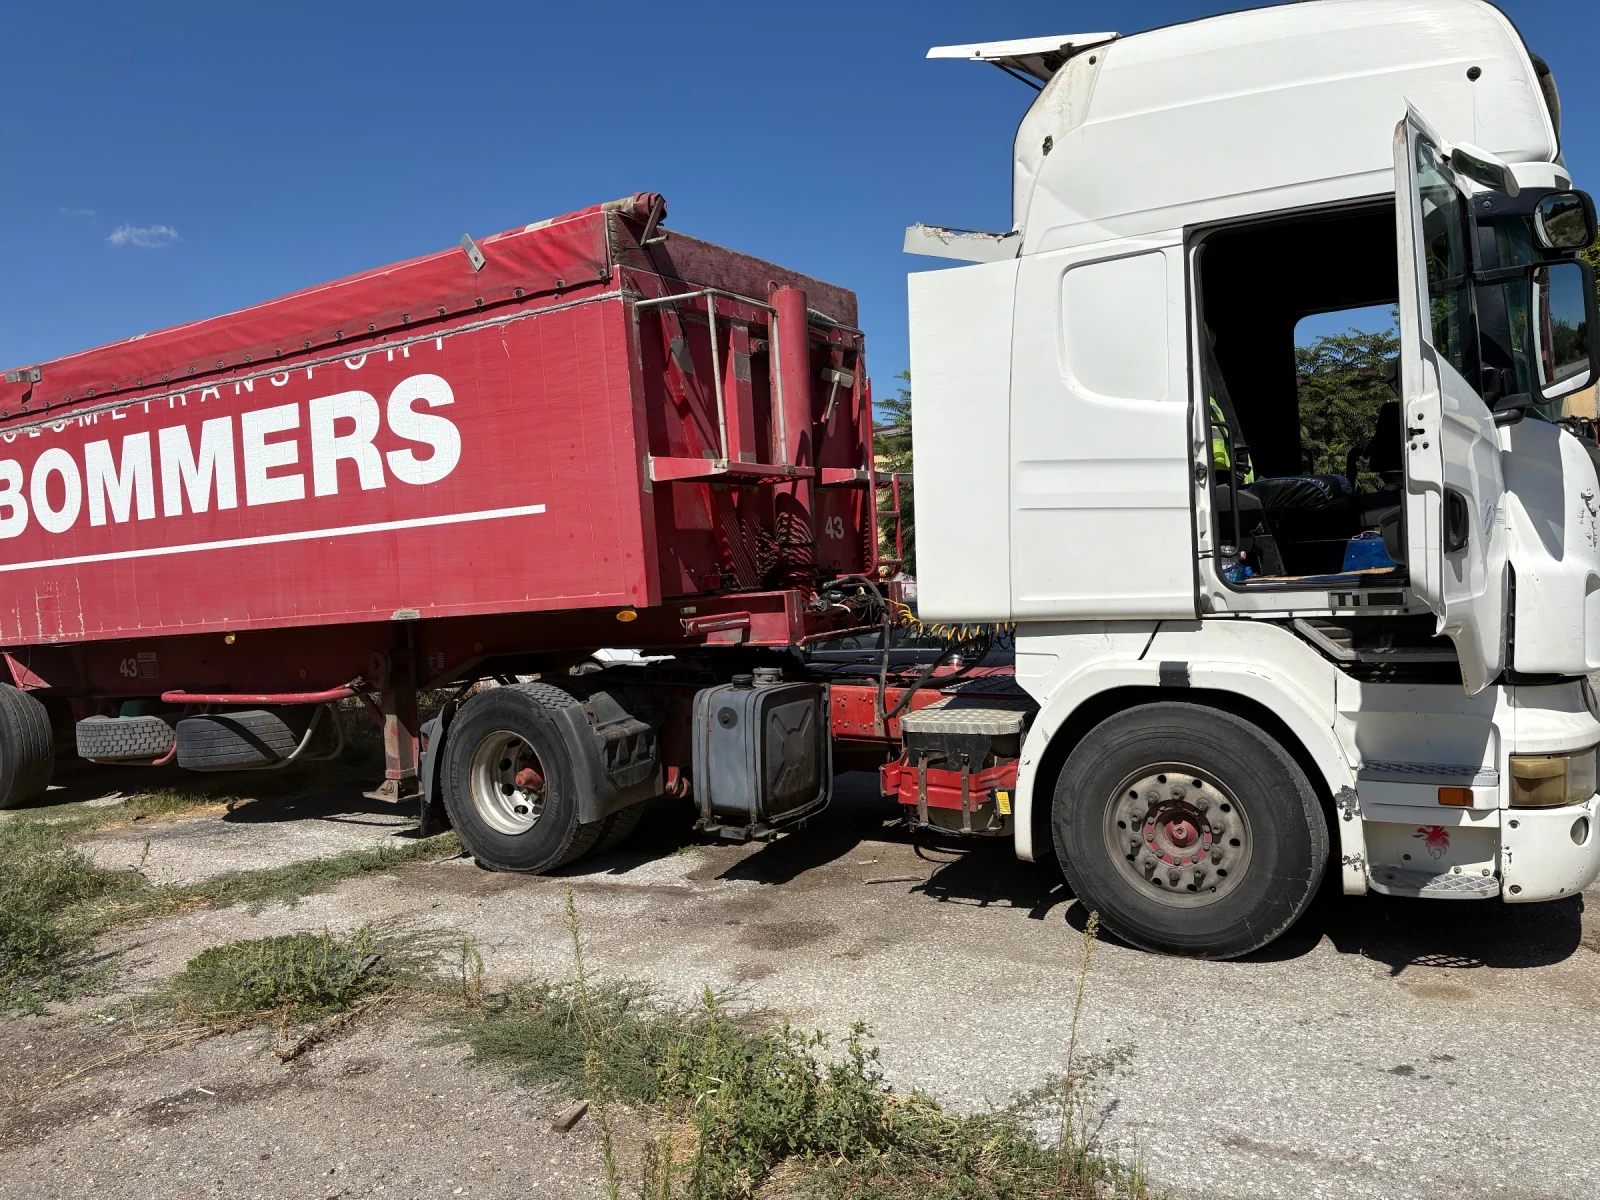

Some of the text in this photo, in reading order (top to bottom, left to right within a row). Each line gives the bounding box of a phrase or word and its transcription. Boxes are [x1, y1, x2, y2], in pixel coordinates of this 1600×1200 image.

[0, 373, 461, 539] BOMMERS
[825, 516, 845, 540] 43
[119, 657, 138, 678] 43
